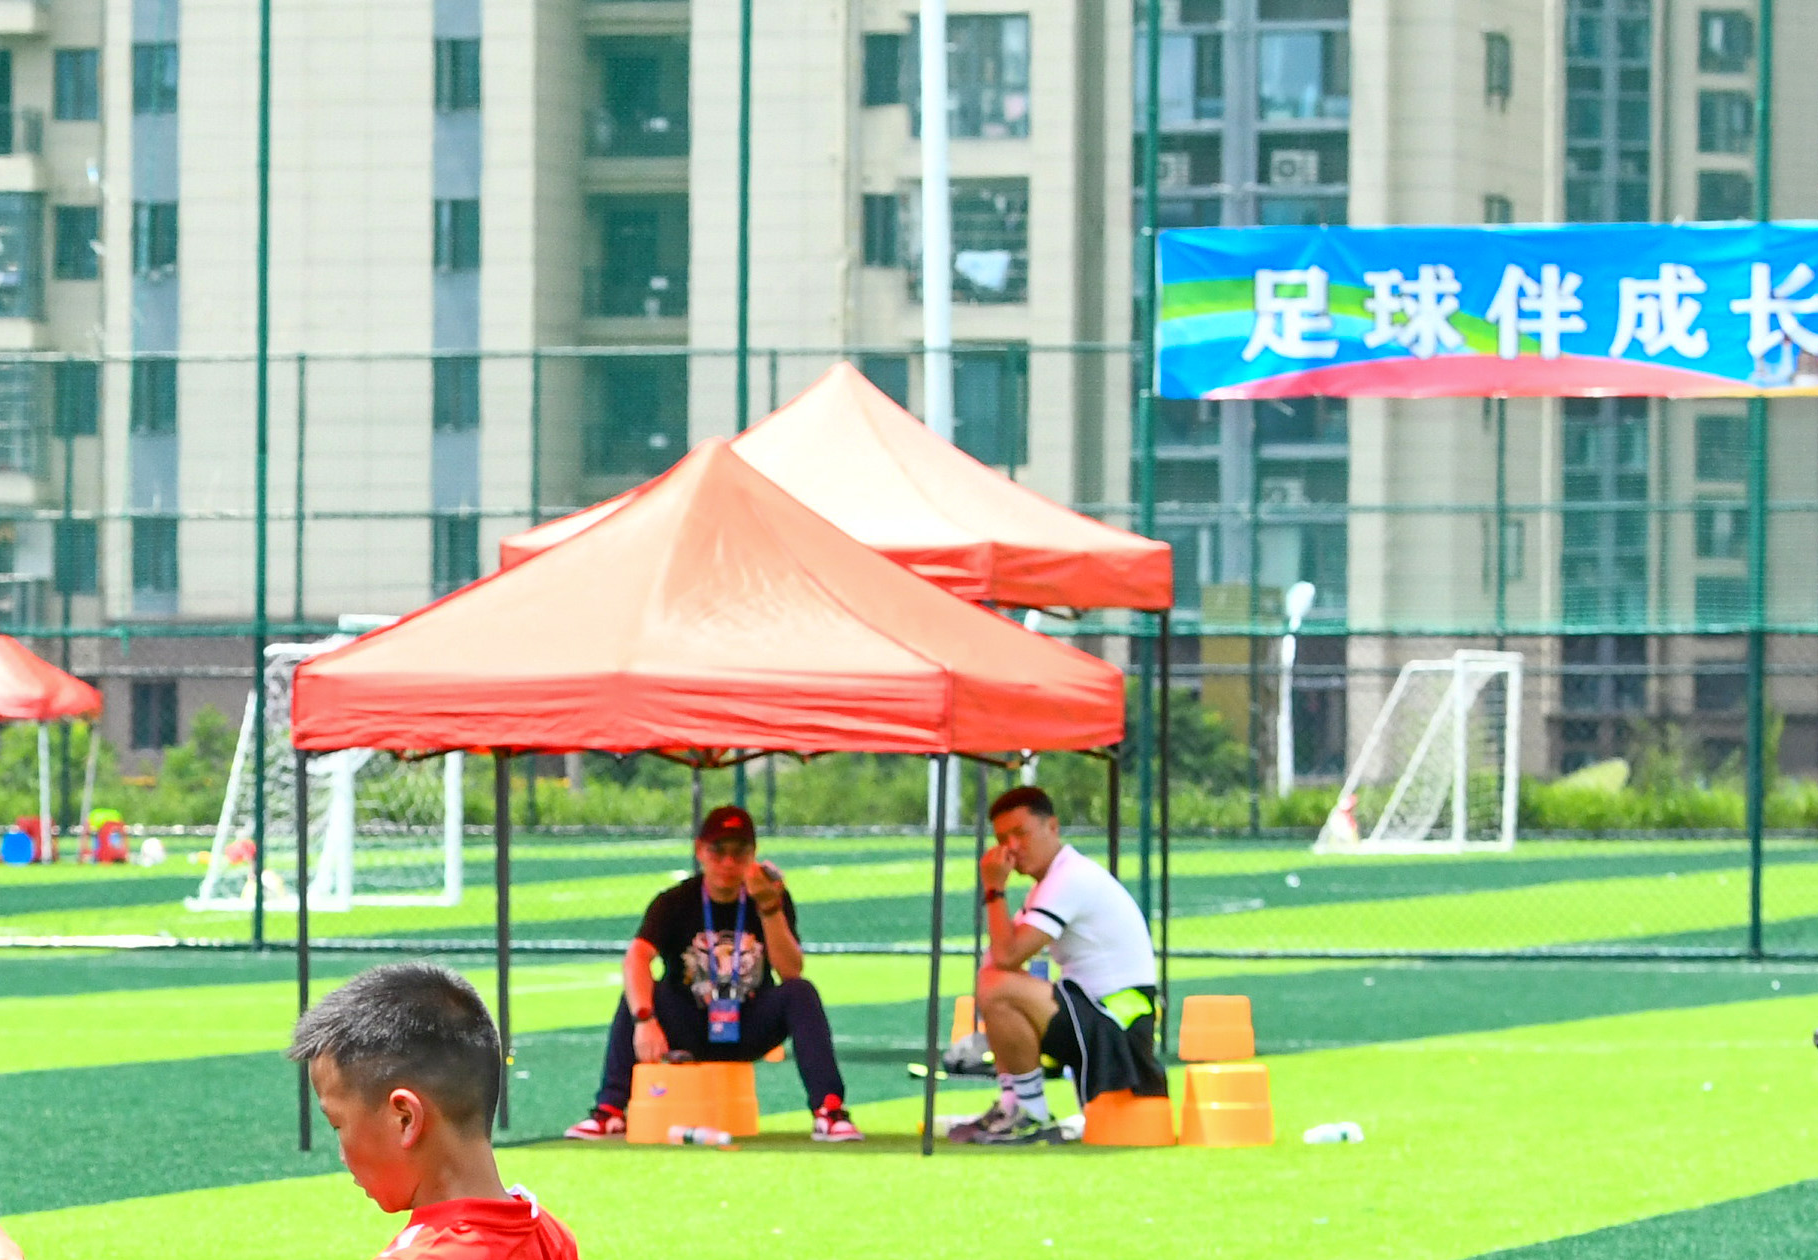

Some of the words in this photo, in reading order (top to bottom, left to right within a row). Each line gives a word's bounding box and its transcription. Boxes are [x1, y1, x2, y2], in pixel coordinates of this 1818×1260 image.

[1241, 262, 1818, 362] 足球伴成长
